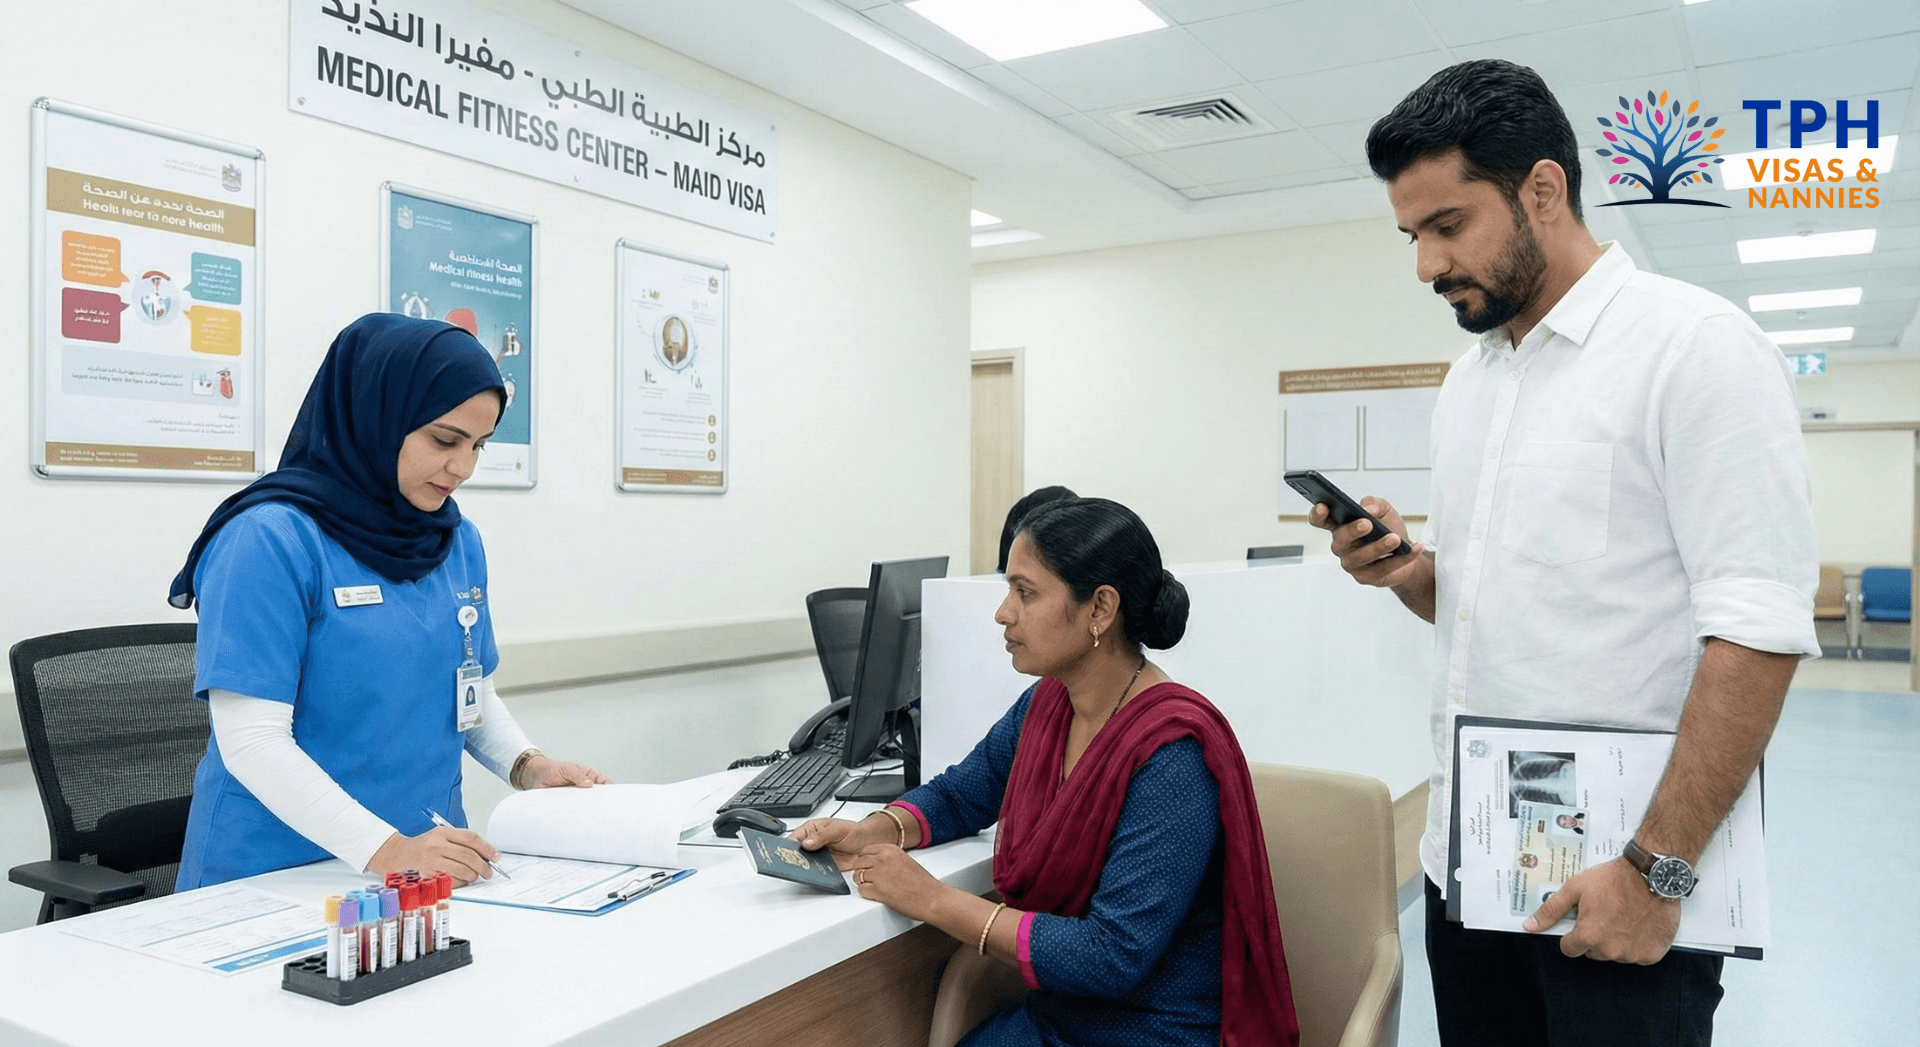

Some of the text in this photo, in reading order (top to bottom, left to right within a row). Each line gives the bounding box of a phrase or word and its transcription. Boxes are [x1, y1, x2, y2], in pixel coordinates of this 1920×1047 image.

[435, 23, 515, 81] مفيرا
[541, 78, 624, 118] الطبي
[317, 45, 449, 120] MEDICAL
[458, 91, 559, 152] FITNESS
[566, 127, 649, 180] CENTER
[673, 160, 722, 201] MAID
[727, 178, 766, 216] VISA
[631, 92, 710, 147] الطبية
[716, 127, 766, 168] مركز
[82, 180, 128, 200] الصحة
[186, 201, 225, 219] الصحة
[429, 260, 465, 277] Medical
